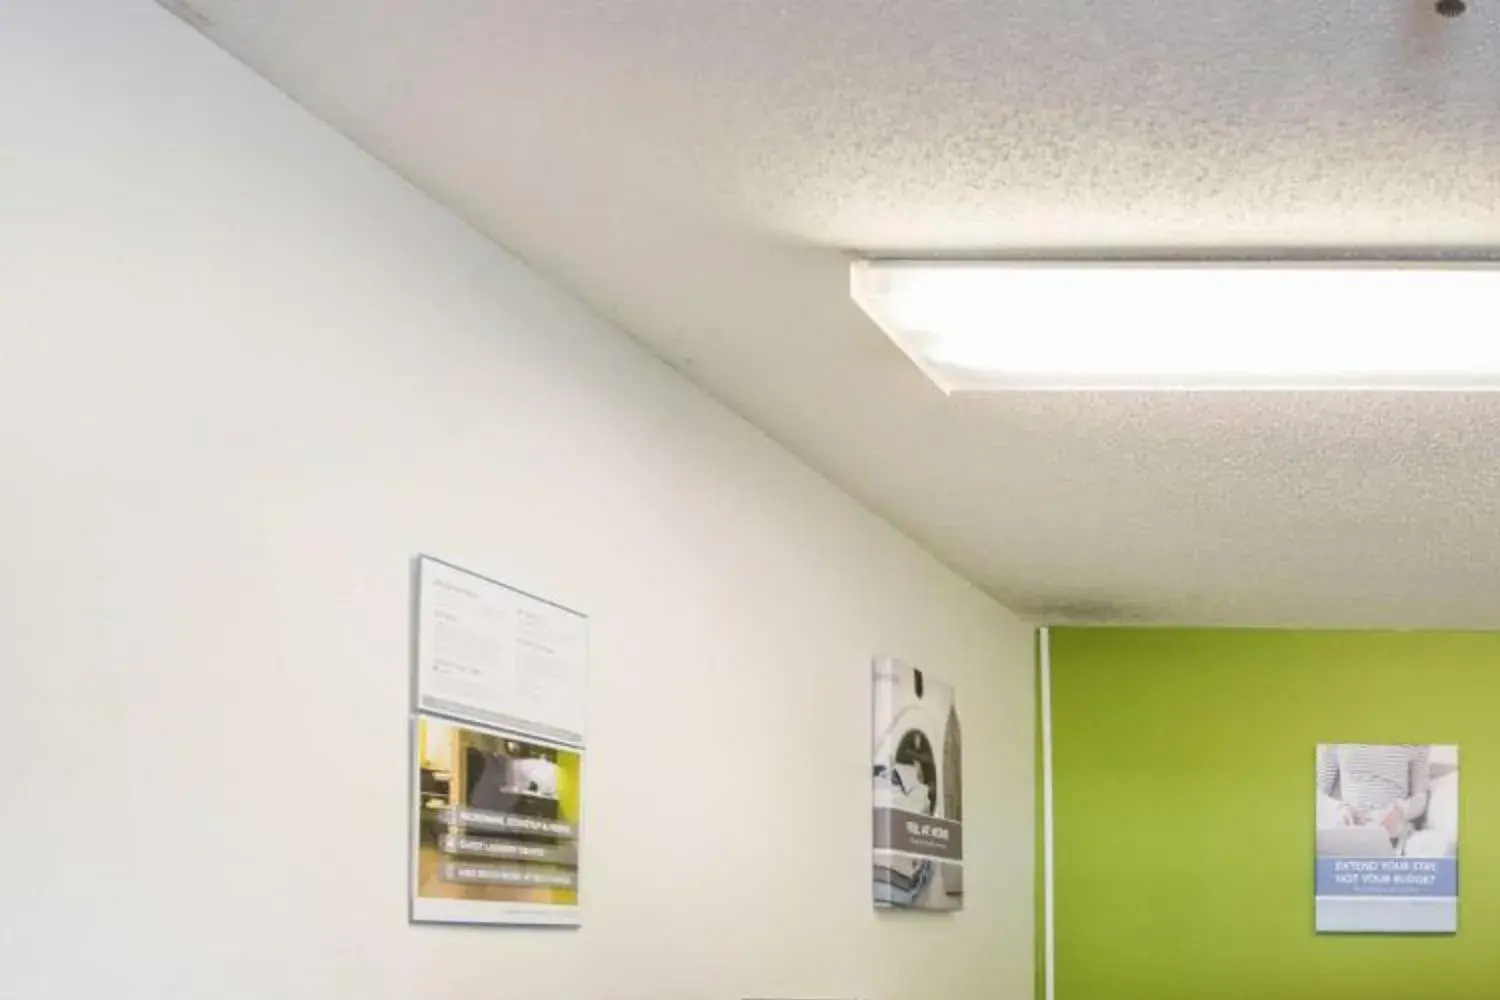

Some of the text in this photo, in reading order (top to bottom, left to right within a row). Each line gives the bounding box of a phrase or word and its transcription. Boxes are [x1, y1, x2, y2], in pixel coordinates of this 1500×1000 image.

[1335, 861, 1377, 872] EXTEND
[1381, 861, 1408, 871] YOUR
[1335, 874, 1358, 884] NOT
[1361, 874, 1390, 884] YOUR
